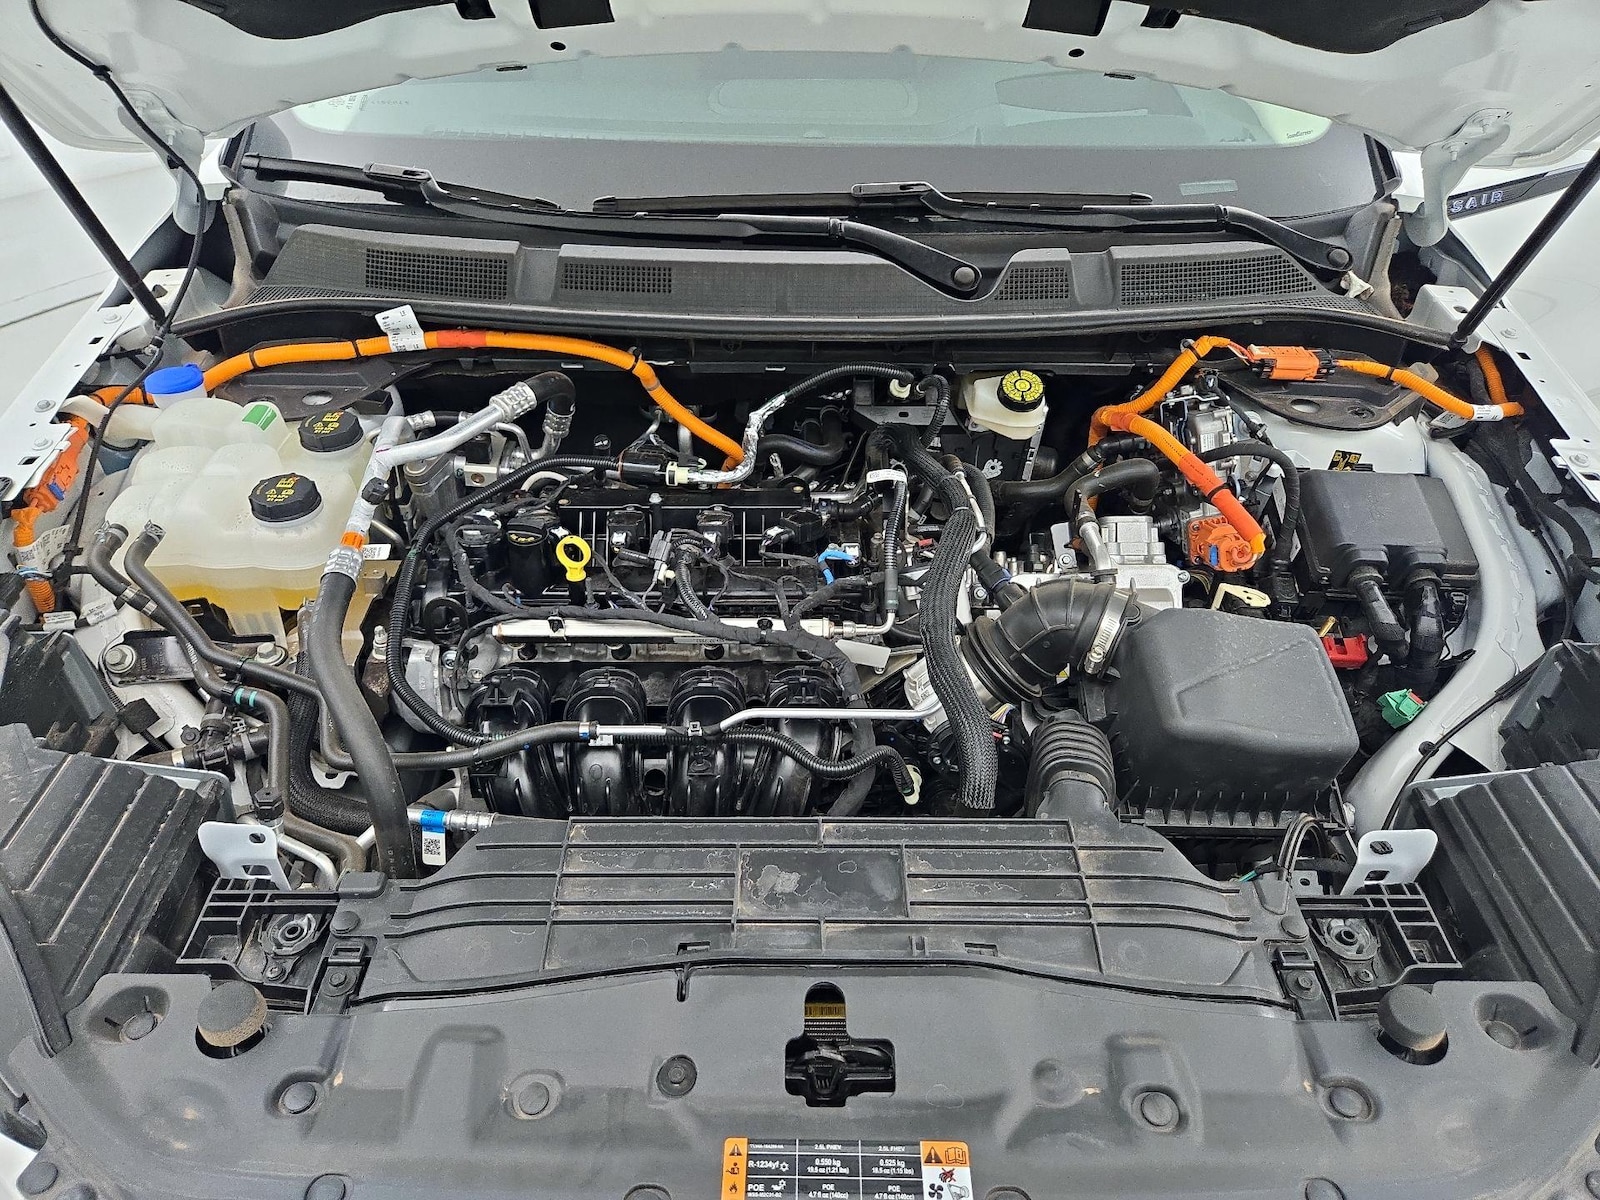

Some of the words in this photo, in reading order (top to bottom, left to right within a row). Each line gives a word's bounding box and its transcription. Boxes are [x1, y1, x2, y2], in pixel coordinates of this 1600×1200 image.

[1450, 190, 1504, 212] SAIR
[748, 1160, 780, 1169] R-1234yf
[832, 1158, 841, 1167] kg
[897, 1160, 905, 1168] kg
